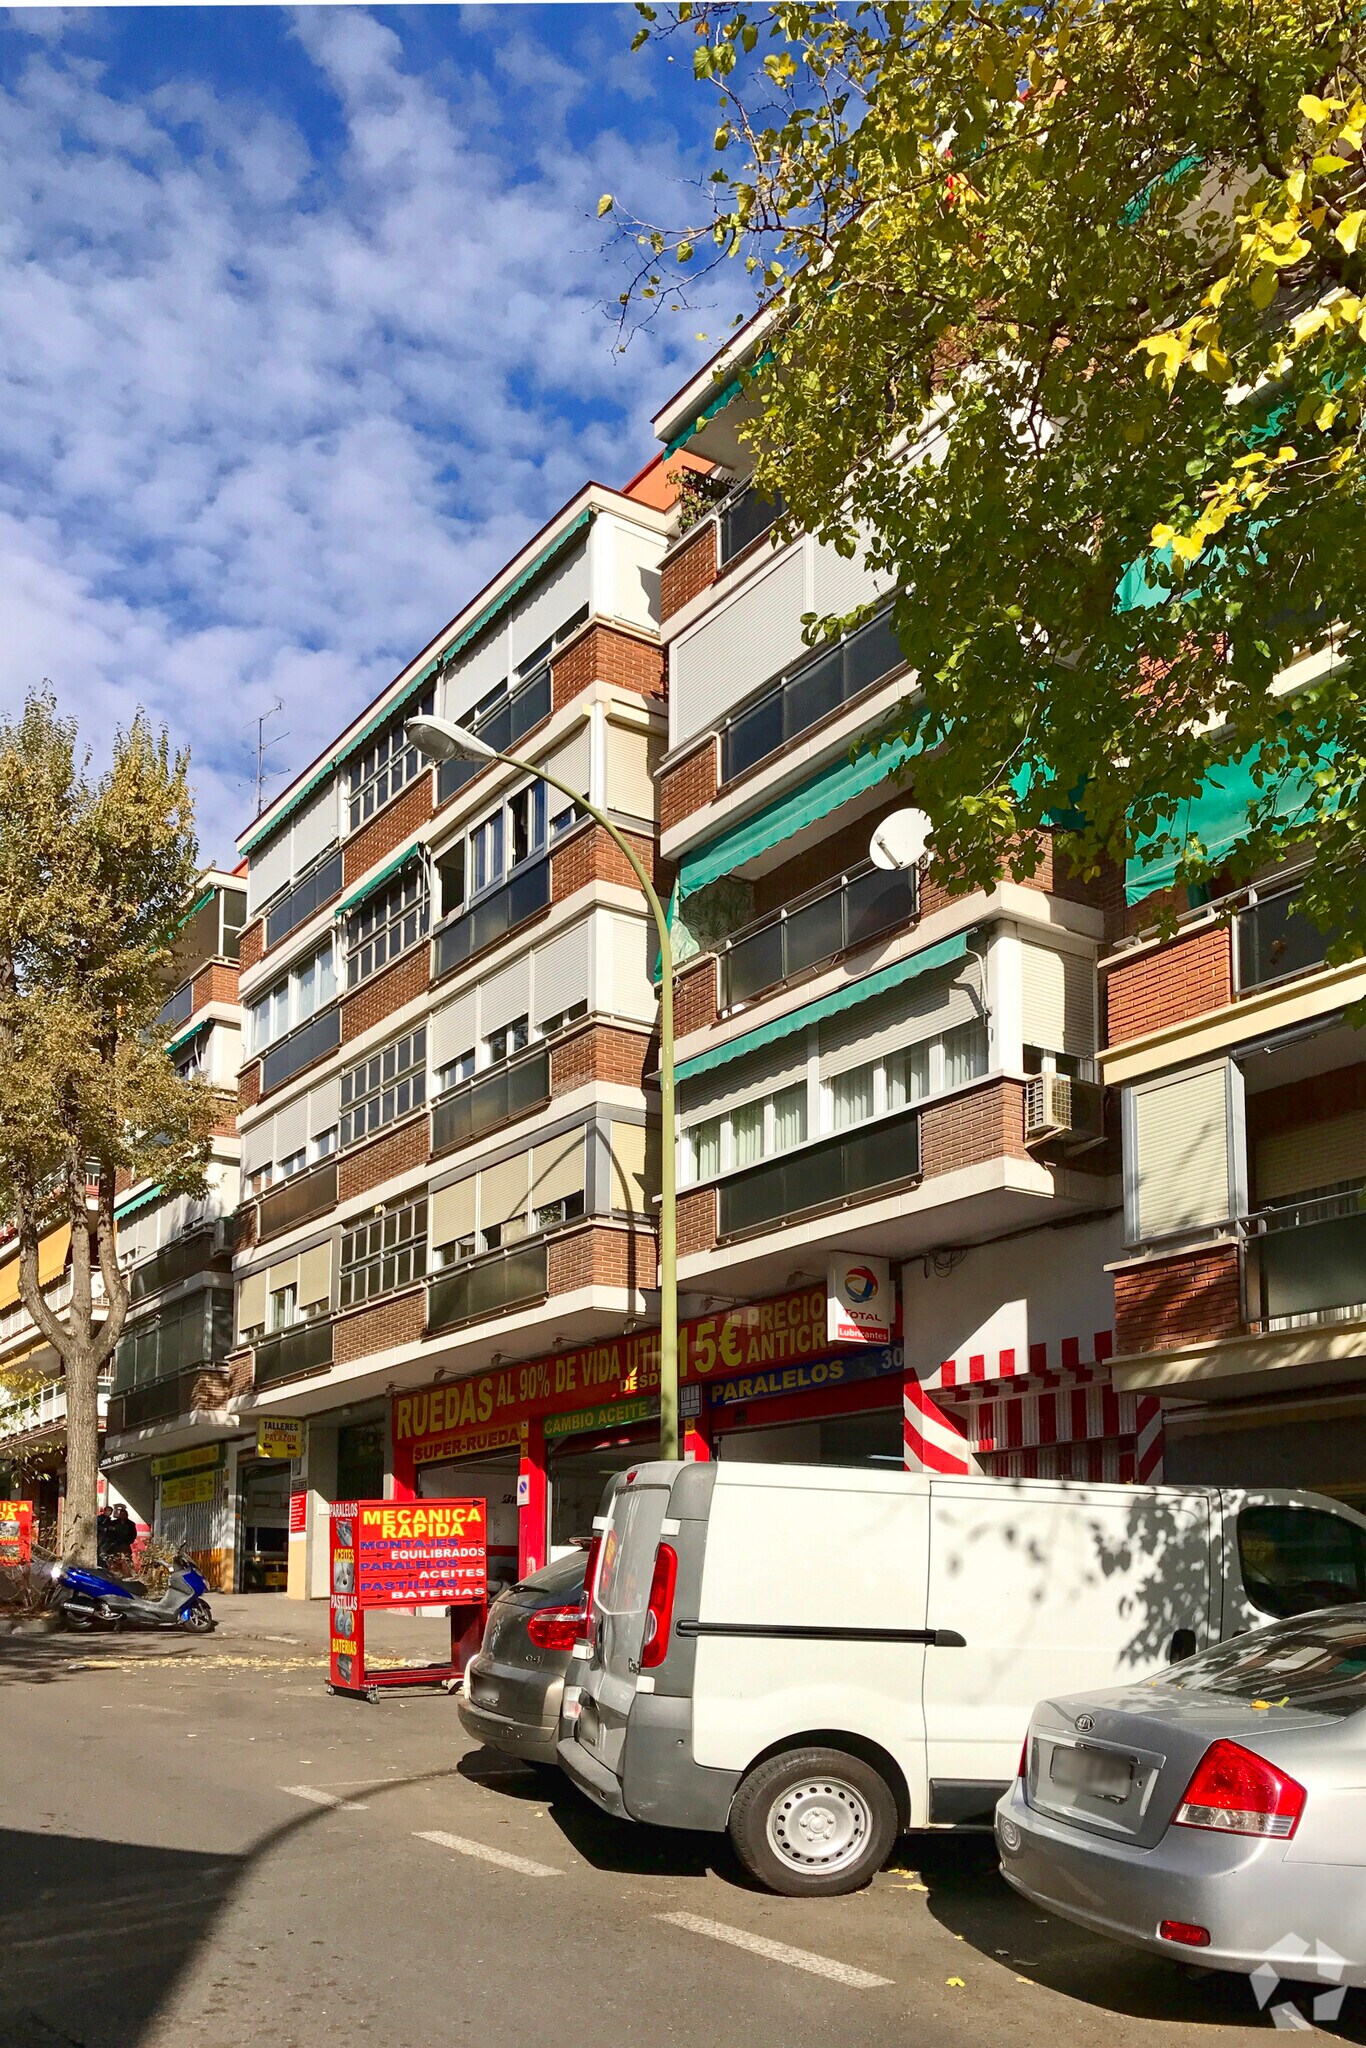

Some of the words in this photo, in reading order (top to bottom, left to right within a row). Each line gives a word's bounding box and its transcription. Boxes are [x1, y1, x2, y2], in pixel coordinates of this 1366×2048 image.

[747, 1292, 825, 1334] PRECIO
[844, 1308, 882, 1322] TOTAL
[838, 1328, 888, 1341] Lubricantes
[747, 1321, 831, 1364] ANTICR
[620, 1371, 662, 1393] DESD
[711, 1361, 845, 1402] PARALELOS
[397, 1379, 493, 1440] RUEDAS
[496, 1378, 515, 1407] AL
[519, 1363, 550, 1401] 90%
[555, 1359, 576, 1393] DE
[581, 1345, 621, 1386] VIDA
[544, 1413, 595, 1435] CAMBIO
[598, 1401, 648, 1424] ACEITE
[264, 1421, 299, 1431] TALLERES
[414, 1427, 519, 1461] SUPER-RUEDA
[330, 1503, 358, 1517] PARALELOS
[363, 1508, 481, 1525] MECANICA
[382, 1523, 465, 1538] RAPIDA
[361, 1538, 459, 1550] MONTAJES
[334, 1549, 355, 1563] ACEITES
[391, 1547, 486, 1560] EQUILIBRADOS
[361, 1559, 459, 1571] PARALELOS
[419, 1568, 486, 1579] ACEITES
[361, 1579, 458, 1591] PASTILLAS
[391, 1587, 486, 1600] BATERIAS
[331, 1594, 358, 1611] PASTILLAS
[332, 1638, 357, 1656] BATERIAS
